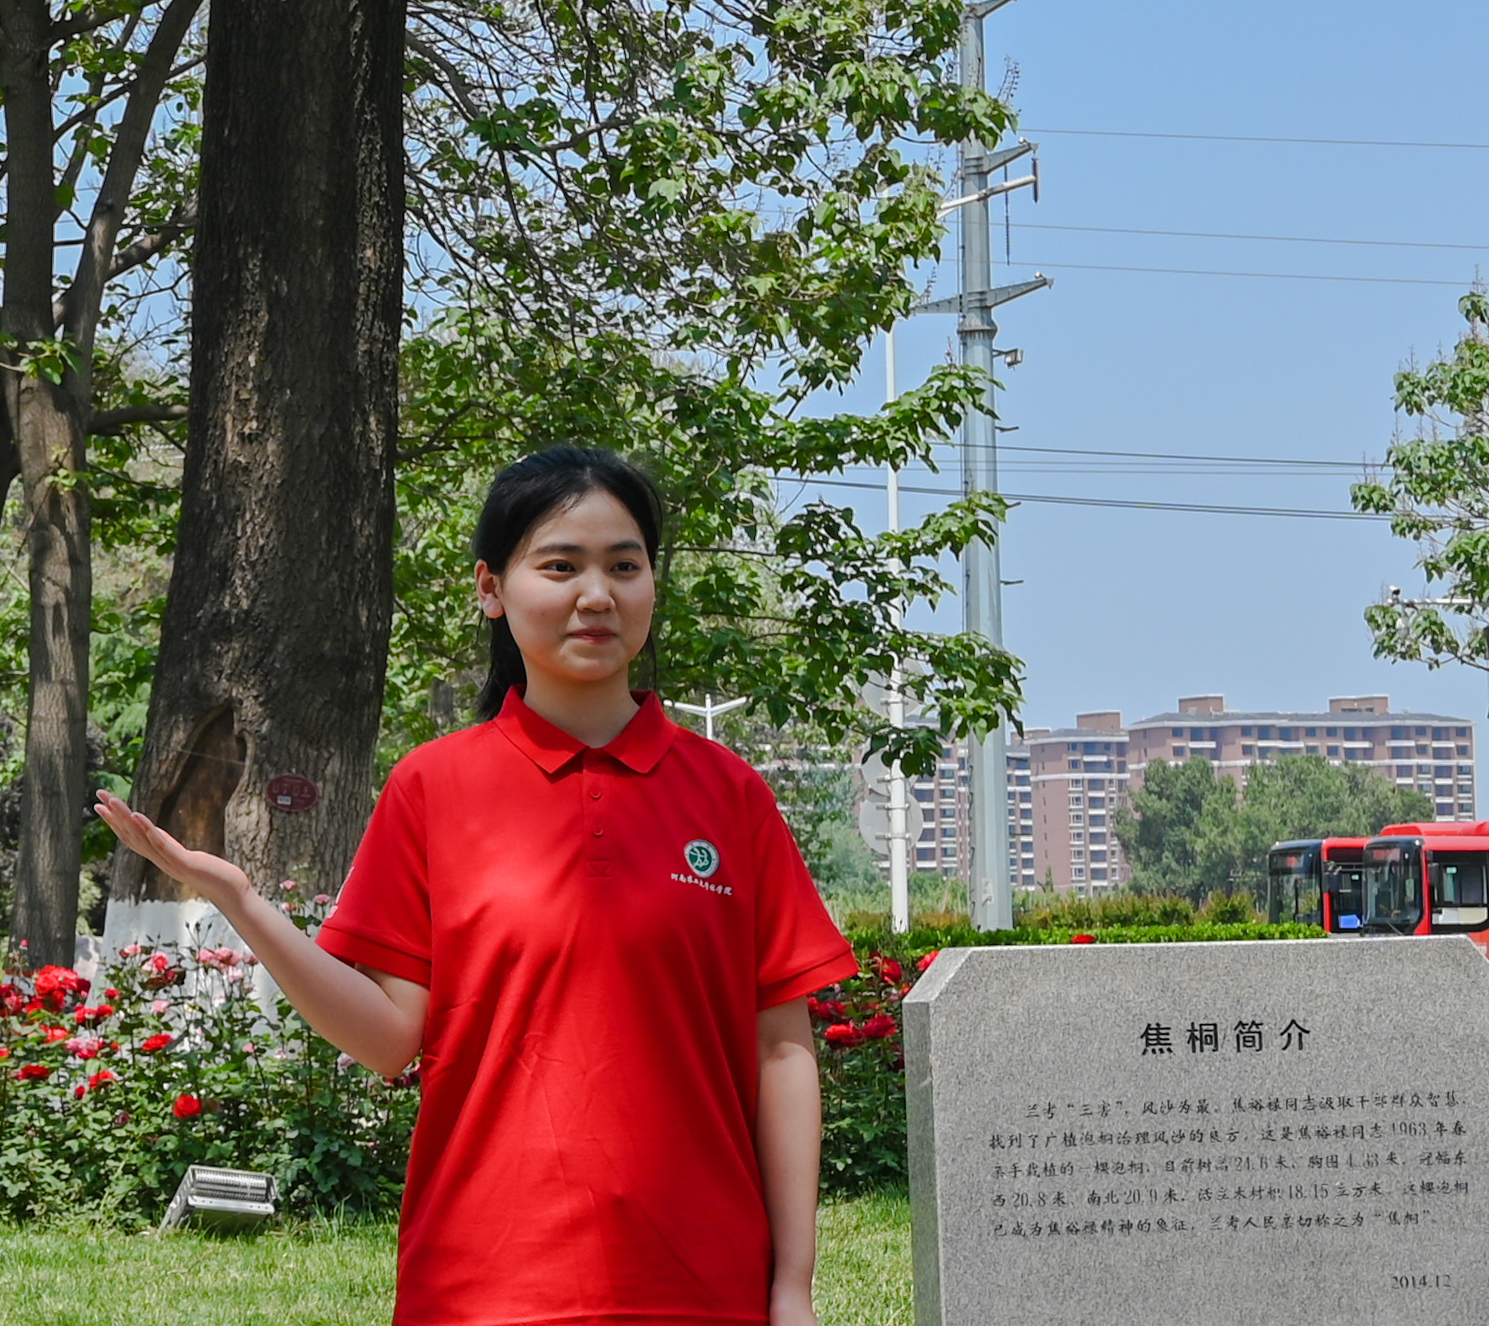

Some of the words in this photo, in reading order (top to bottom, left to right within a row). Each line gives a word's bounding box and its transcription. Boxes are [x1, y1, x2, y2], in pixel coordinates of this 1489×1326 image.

[1140, 1018, 1311, 1056] 焦桐简介
[1391, 1274, 1451, 1290] 2014.12
